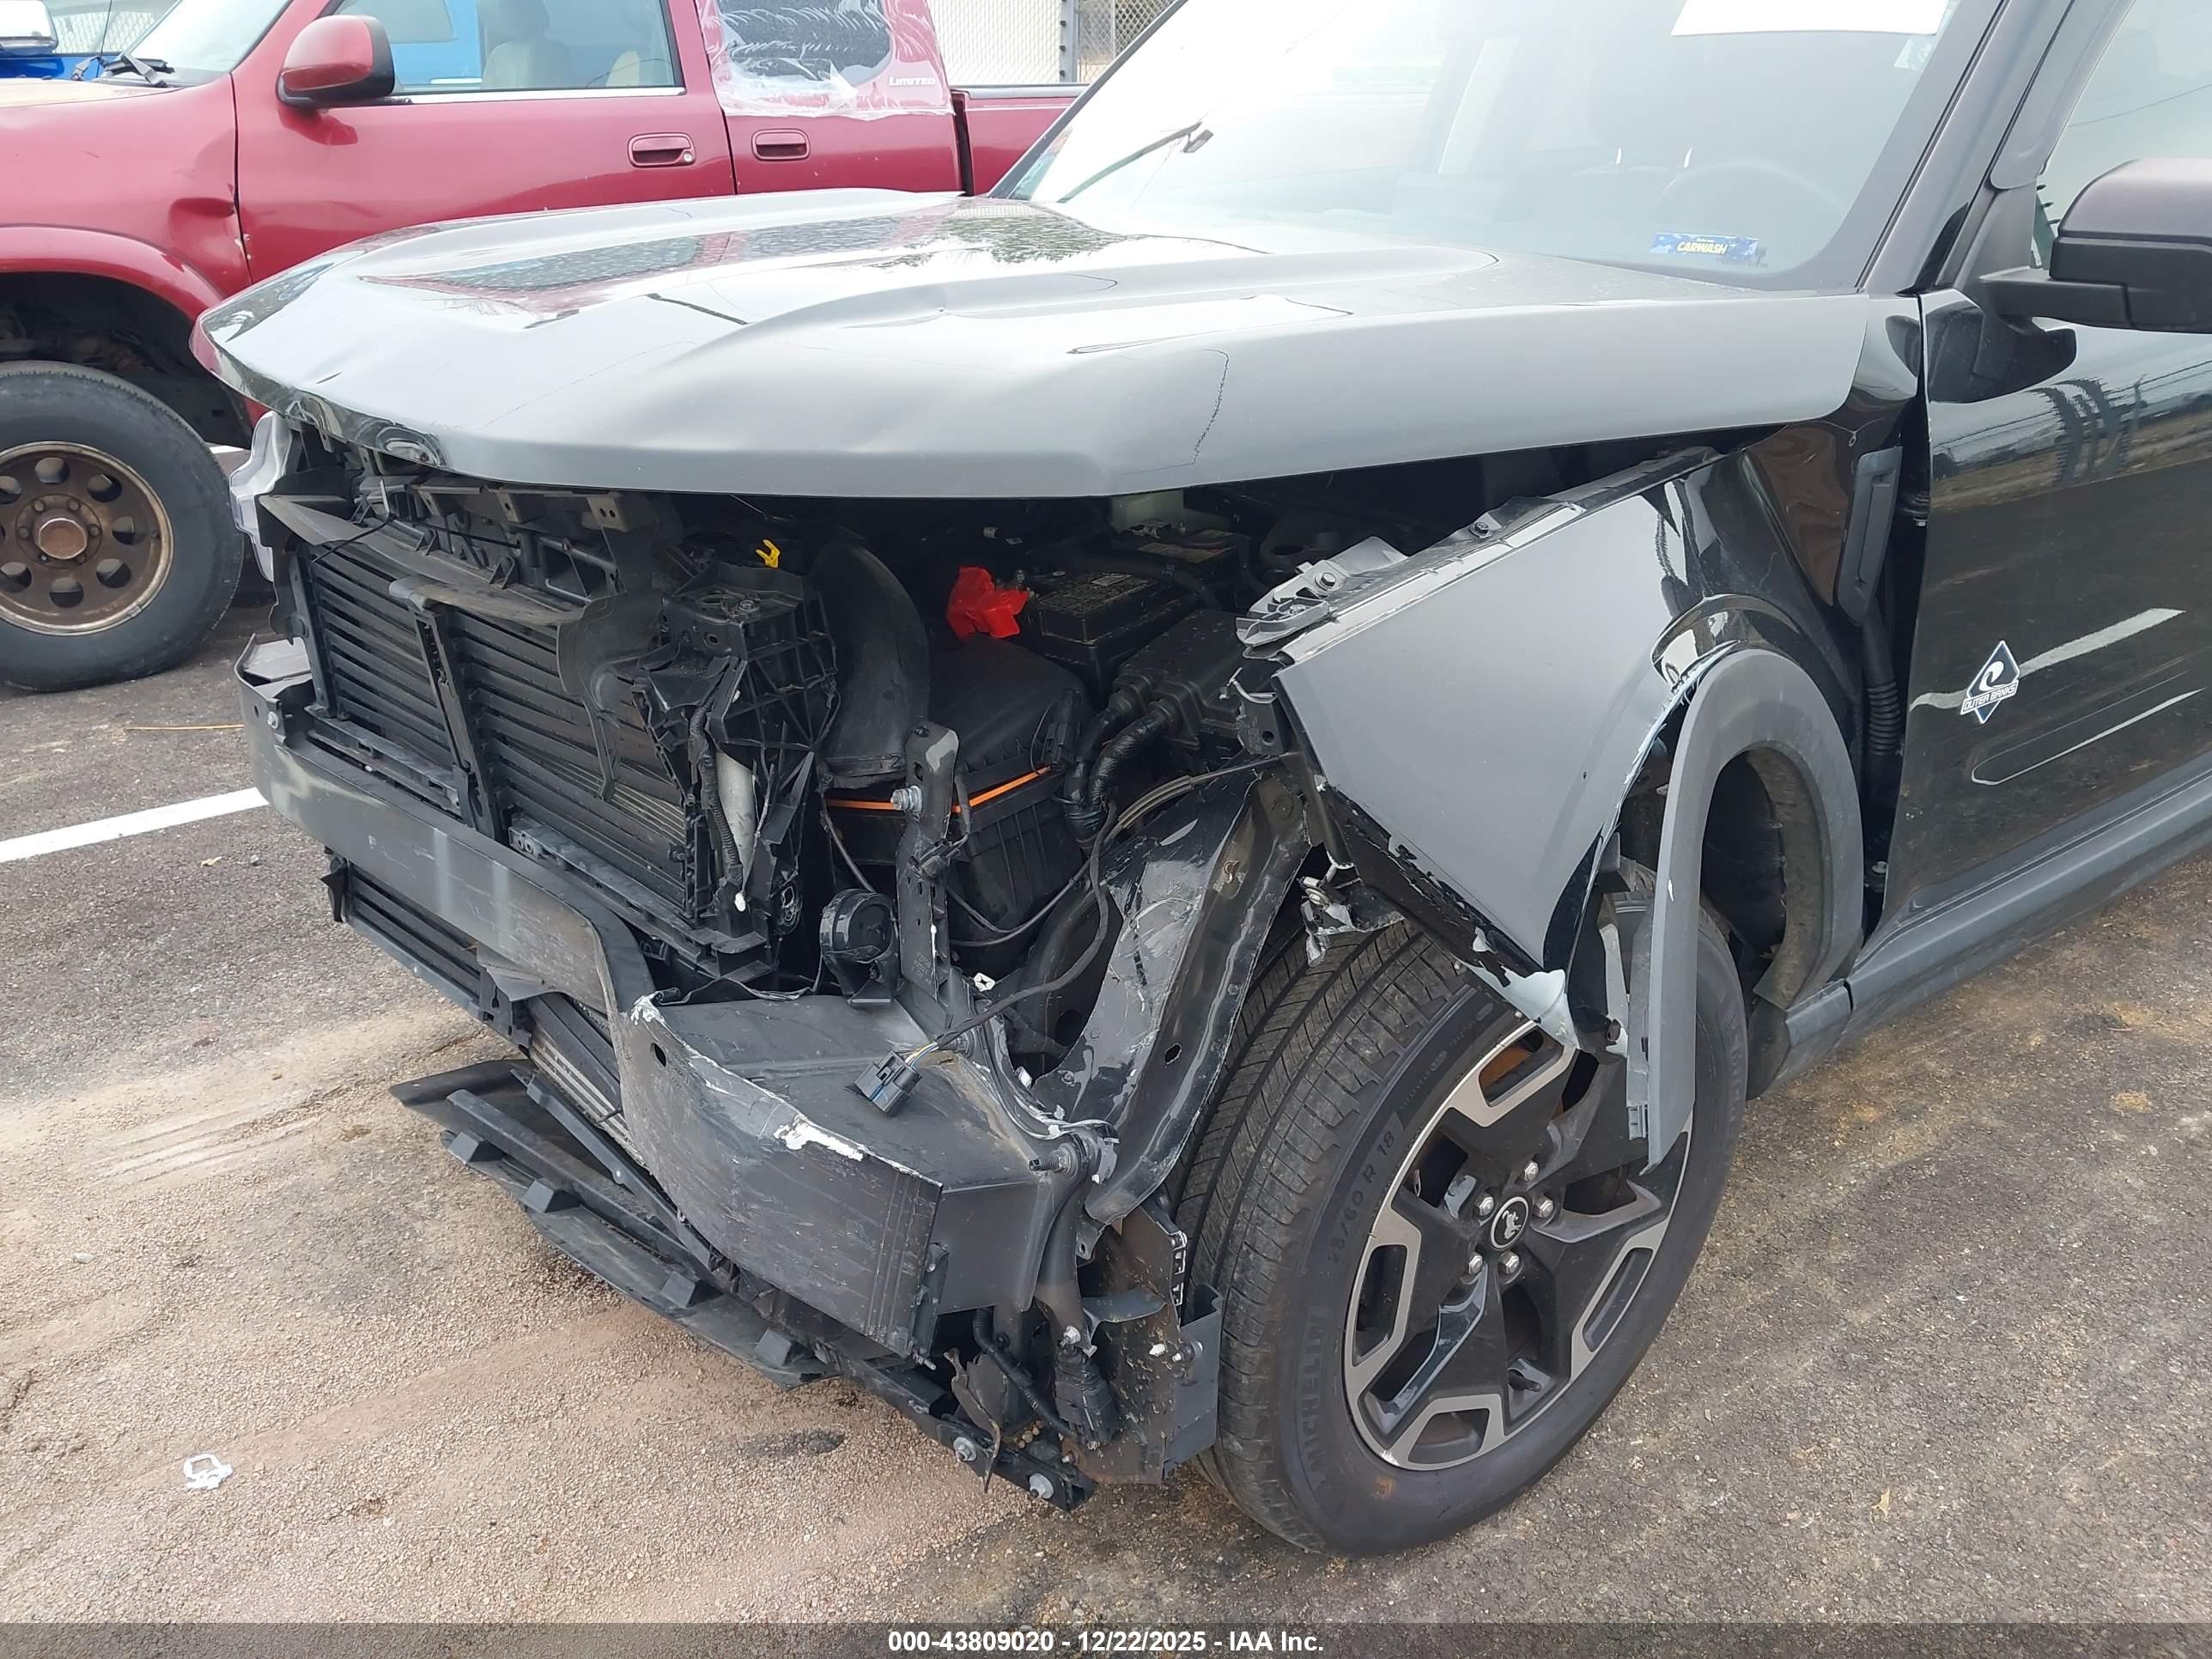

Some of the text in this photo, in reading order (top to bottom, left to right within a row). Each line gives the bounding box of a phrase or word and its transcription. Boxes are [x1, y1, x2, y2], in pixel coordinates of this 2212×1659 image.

[890, 76, 935, 86] LIMITED
[1677, 241, 1728, 254] CARWASH
[1964, 684, 2015, 710] OUTER BANKS
